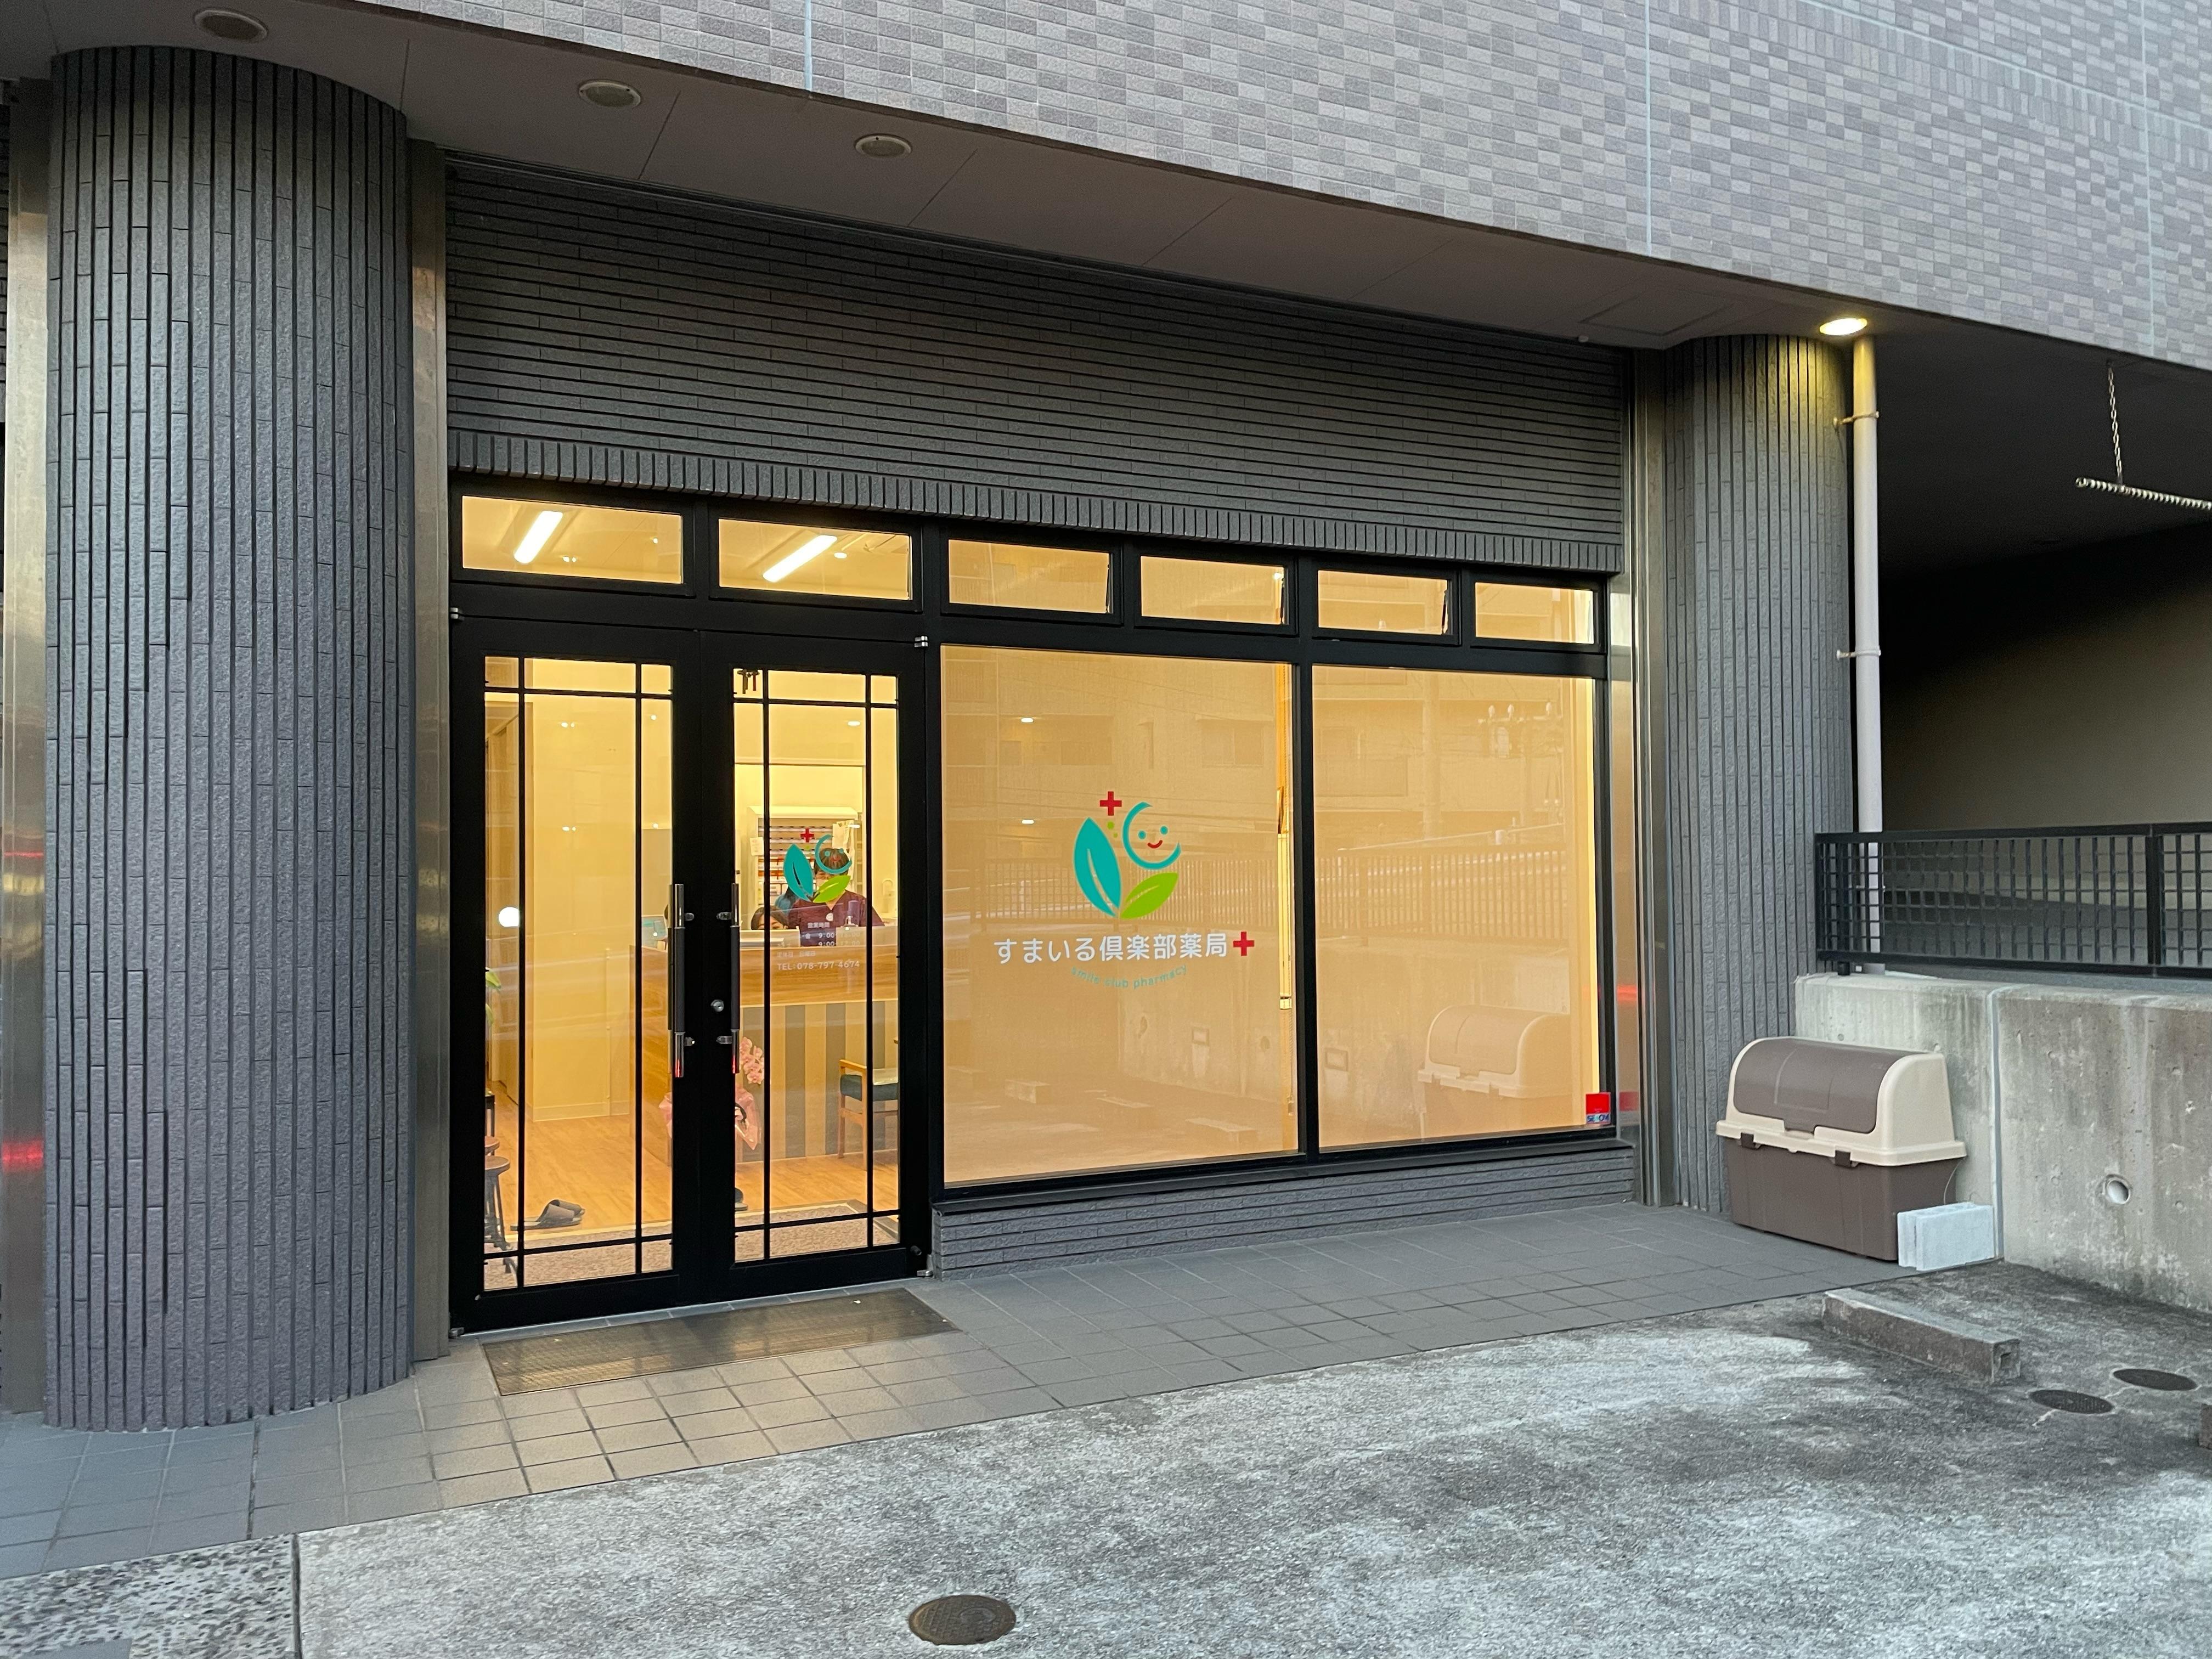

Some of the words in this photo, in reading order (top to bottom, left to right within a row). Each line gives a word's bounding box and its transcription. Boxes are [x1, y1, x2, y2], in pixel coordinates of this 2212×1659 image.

[994, 933, 1228, 964] すまいる倶楽部薬局
[1071, 966, 1100, 984] smile
[1104, 977, 1129, 988] club
[1132, 965, 1188, 990] pharmacy
